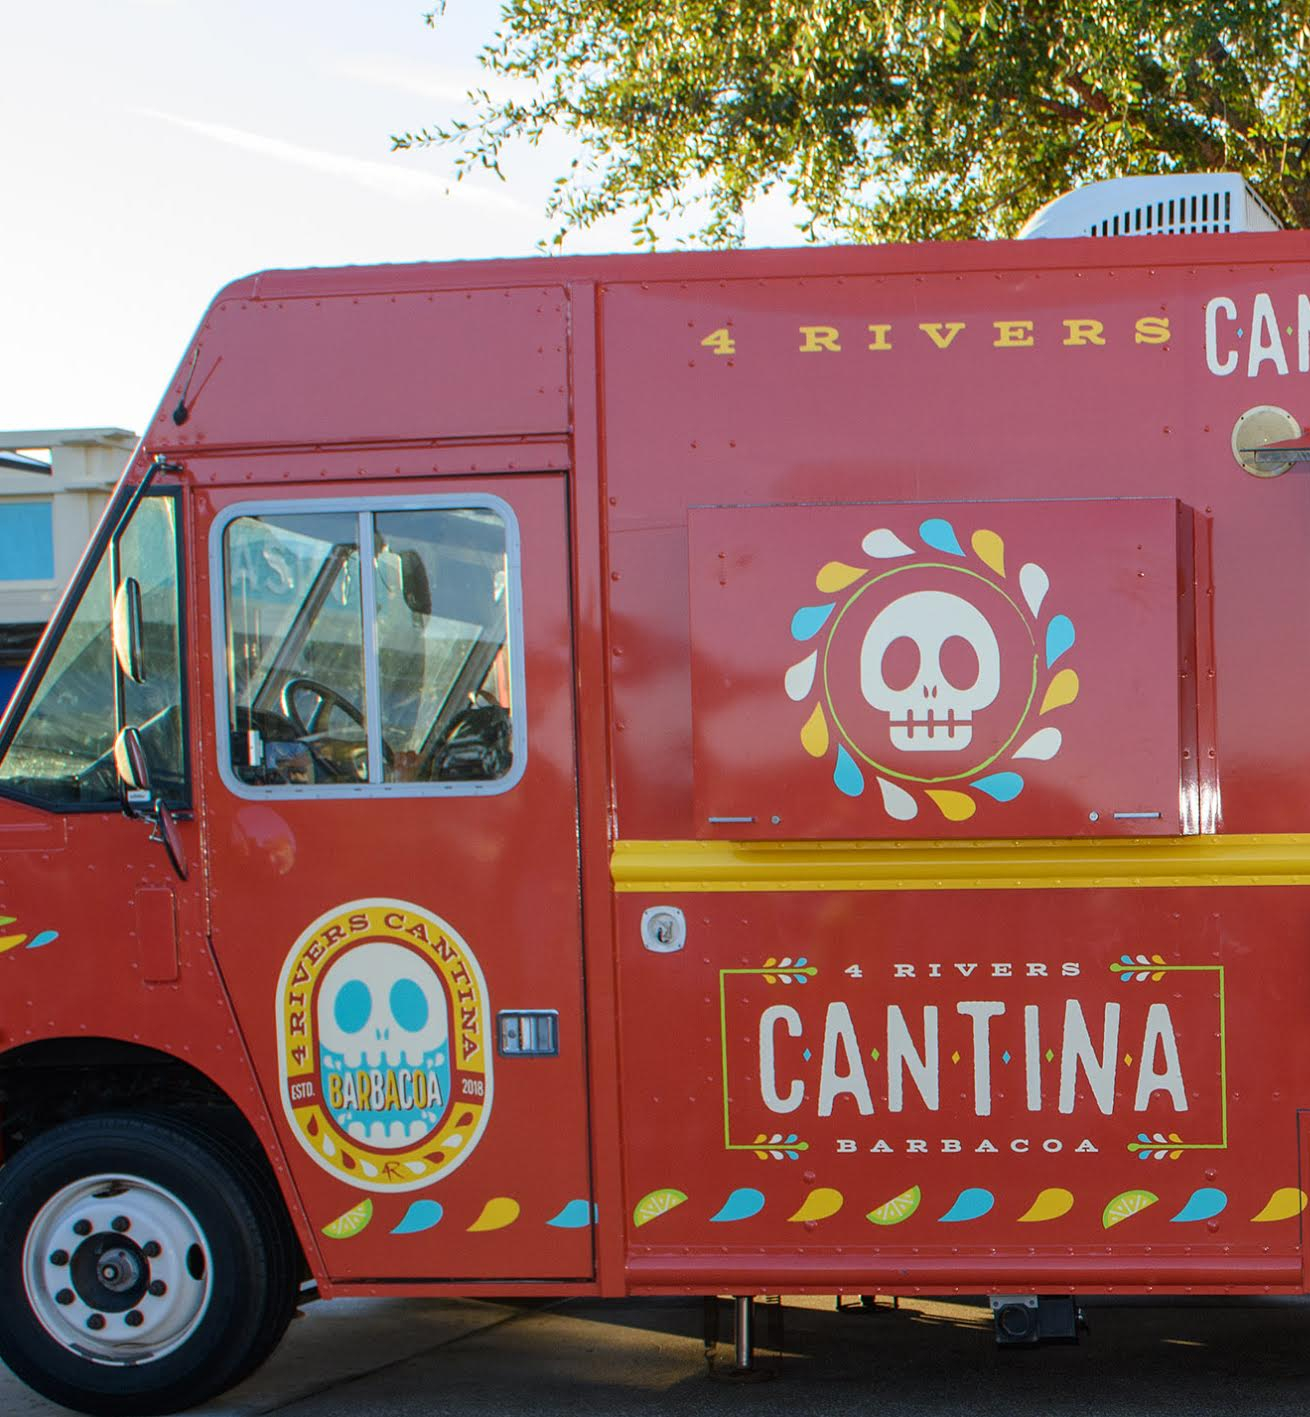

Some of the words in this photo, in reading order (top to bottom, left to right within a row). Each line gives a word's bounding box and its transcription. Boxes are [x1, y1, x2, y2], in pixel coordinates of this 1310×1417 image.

[701, 329, 735, 354] 4
[799, 317, 1171, 352] RIVERS
[289, 913, 369, 1036] RIVERS
[845, 963, 863, 978] 4
[894, 961, 1081, 978] RIVERS
[384, 912, 479, 1061] CANTINA
[291, 1045, 307, 1067] 4
[759, 999, 1189, 1117] CANTINA
[291, 1081, 315, 1100] ESTD.
[328, 1069, 443, 1111] BARBACOA
[461, 1078, 484, 1097] 2018
[837, 1138, 1099, 1154] BARBACOA
